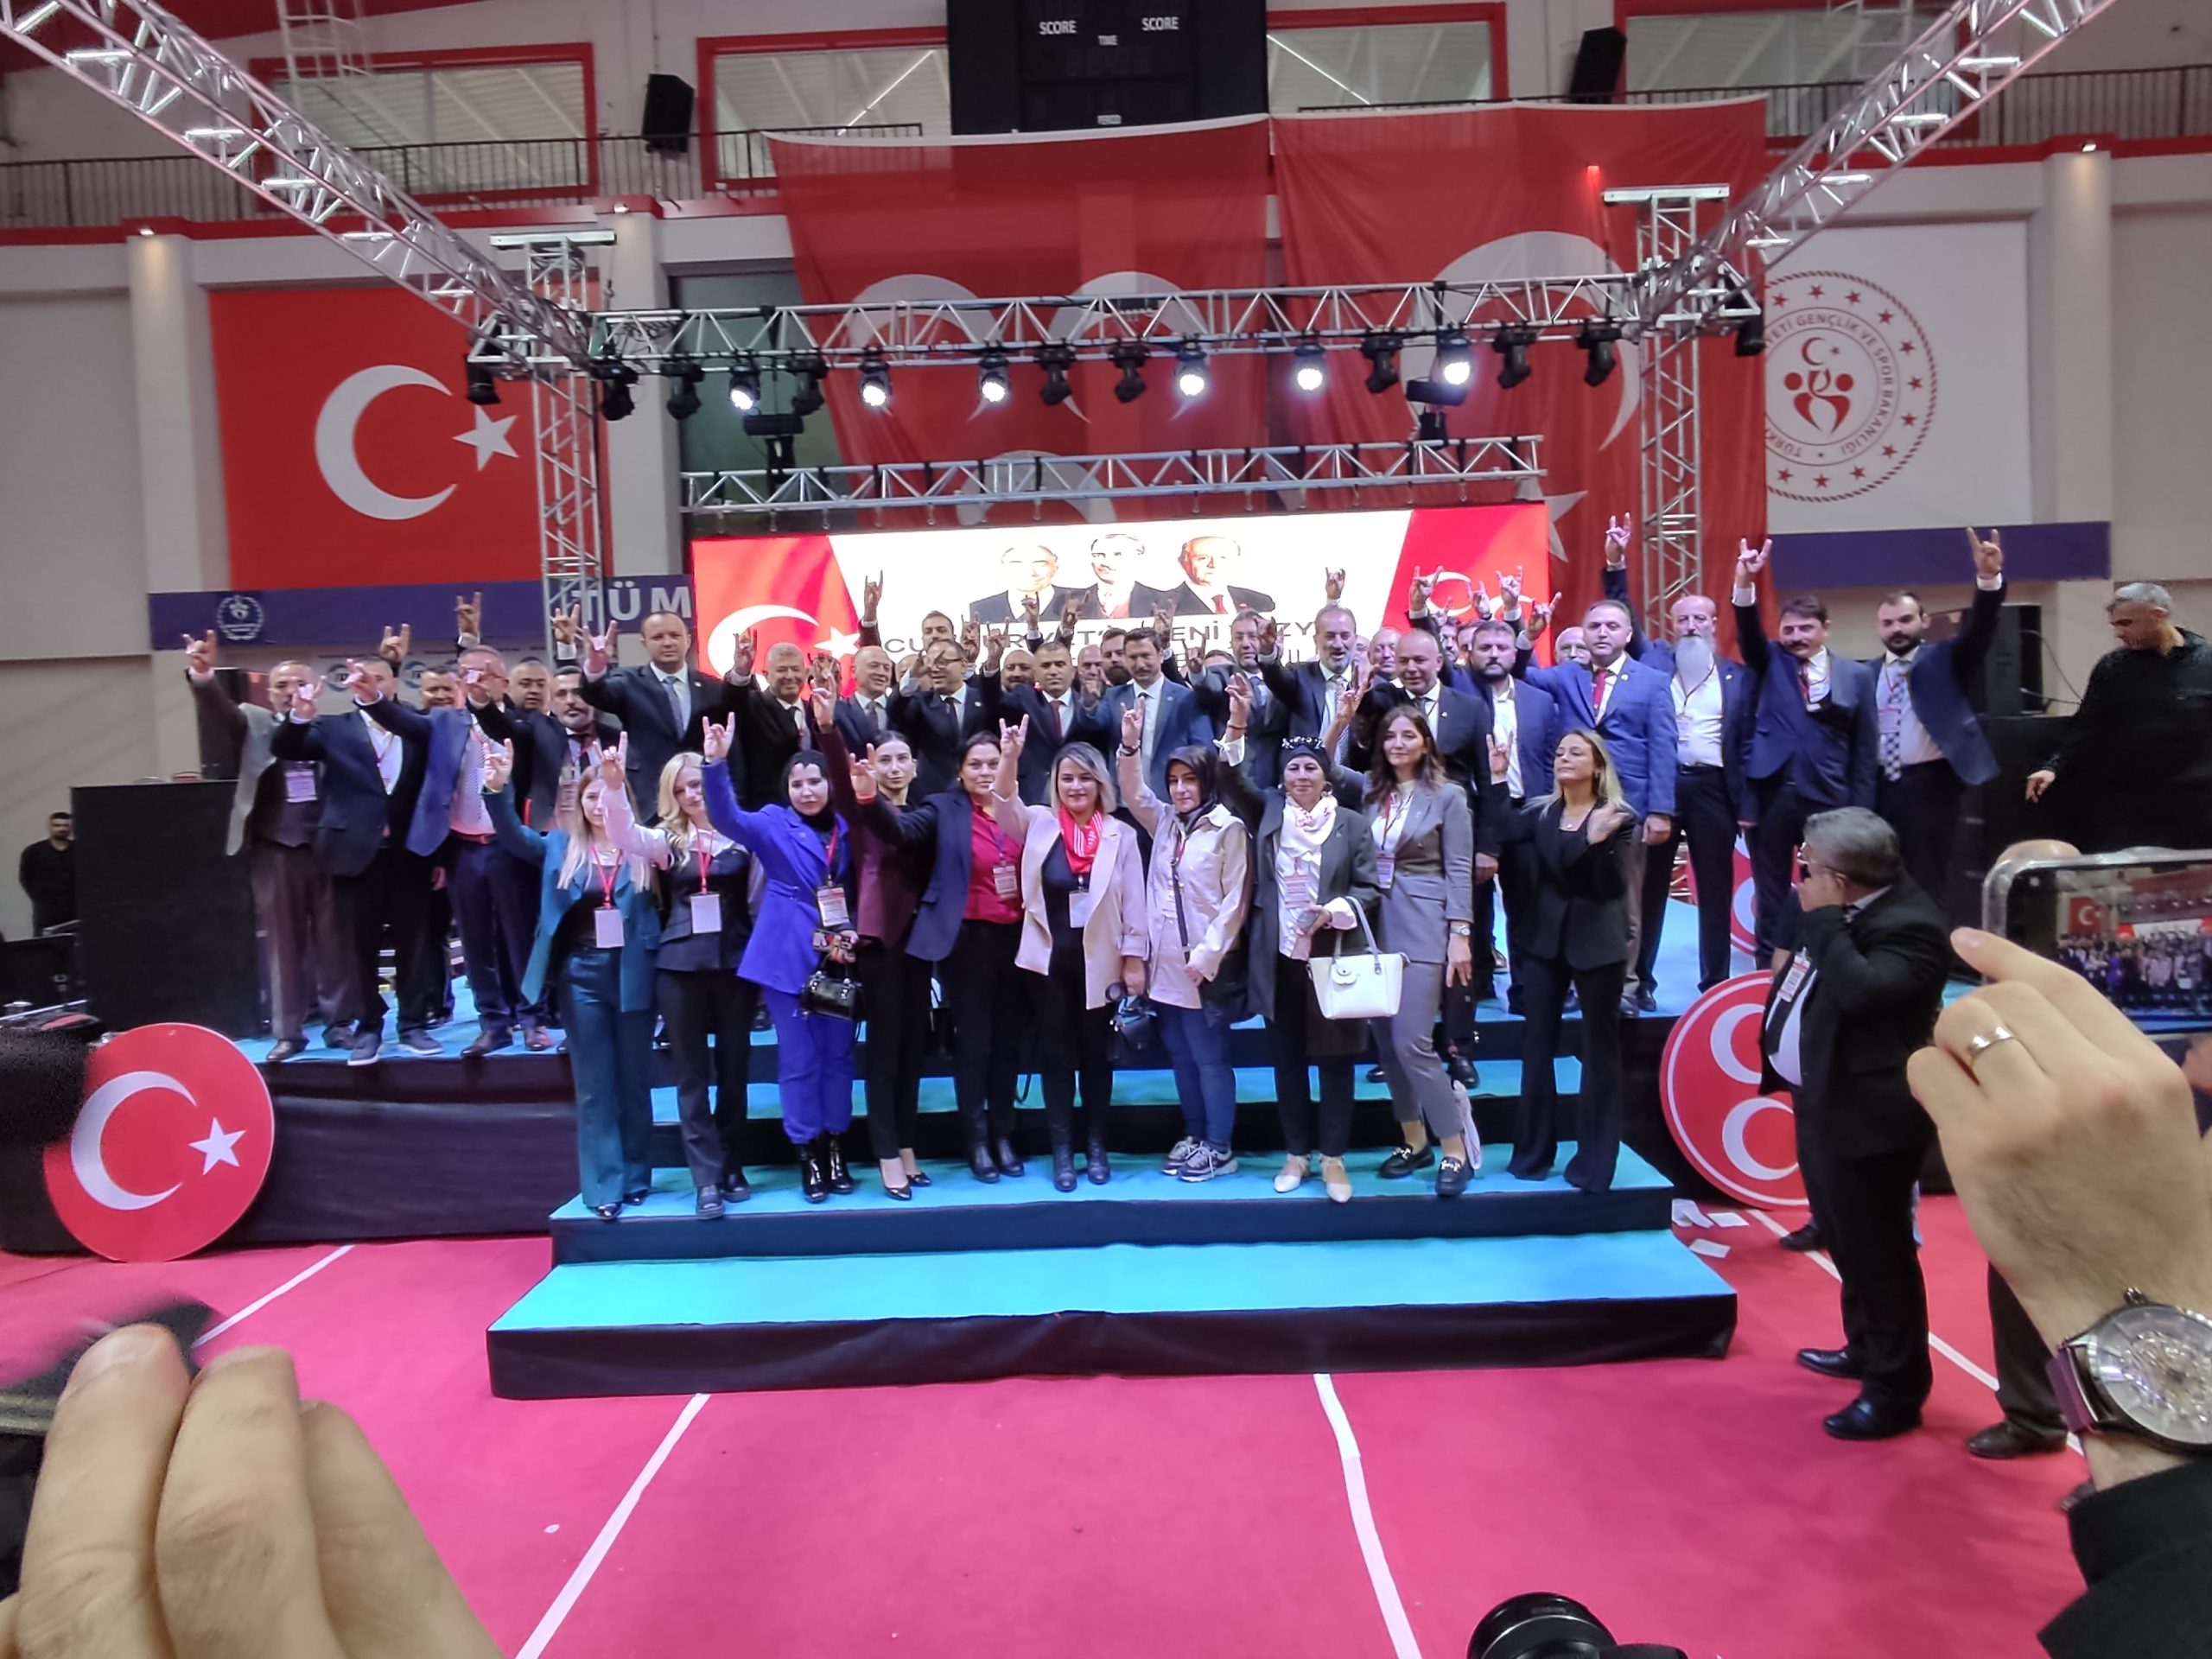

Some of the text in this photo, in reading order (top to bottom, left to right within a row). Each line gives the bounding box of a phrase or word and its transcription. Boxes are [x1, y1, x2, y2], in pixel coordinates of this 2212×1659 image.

[1039, 20, 1077, 35] SCORE
[1141, 16, 1179, 31] SCORE
[1861, 330, 1878, 346] VE
[1874, 347, 1894, 385] SPOR
[1169, 620, 1219, 641] ENİ
